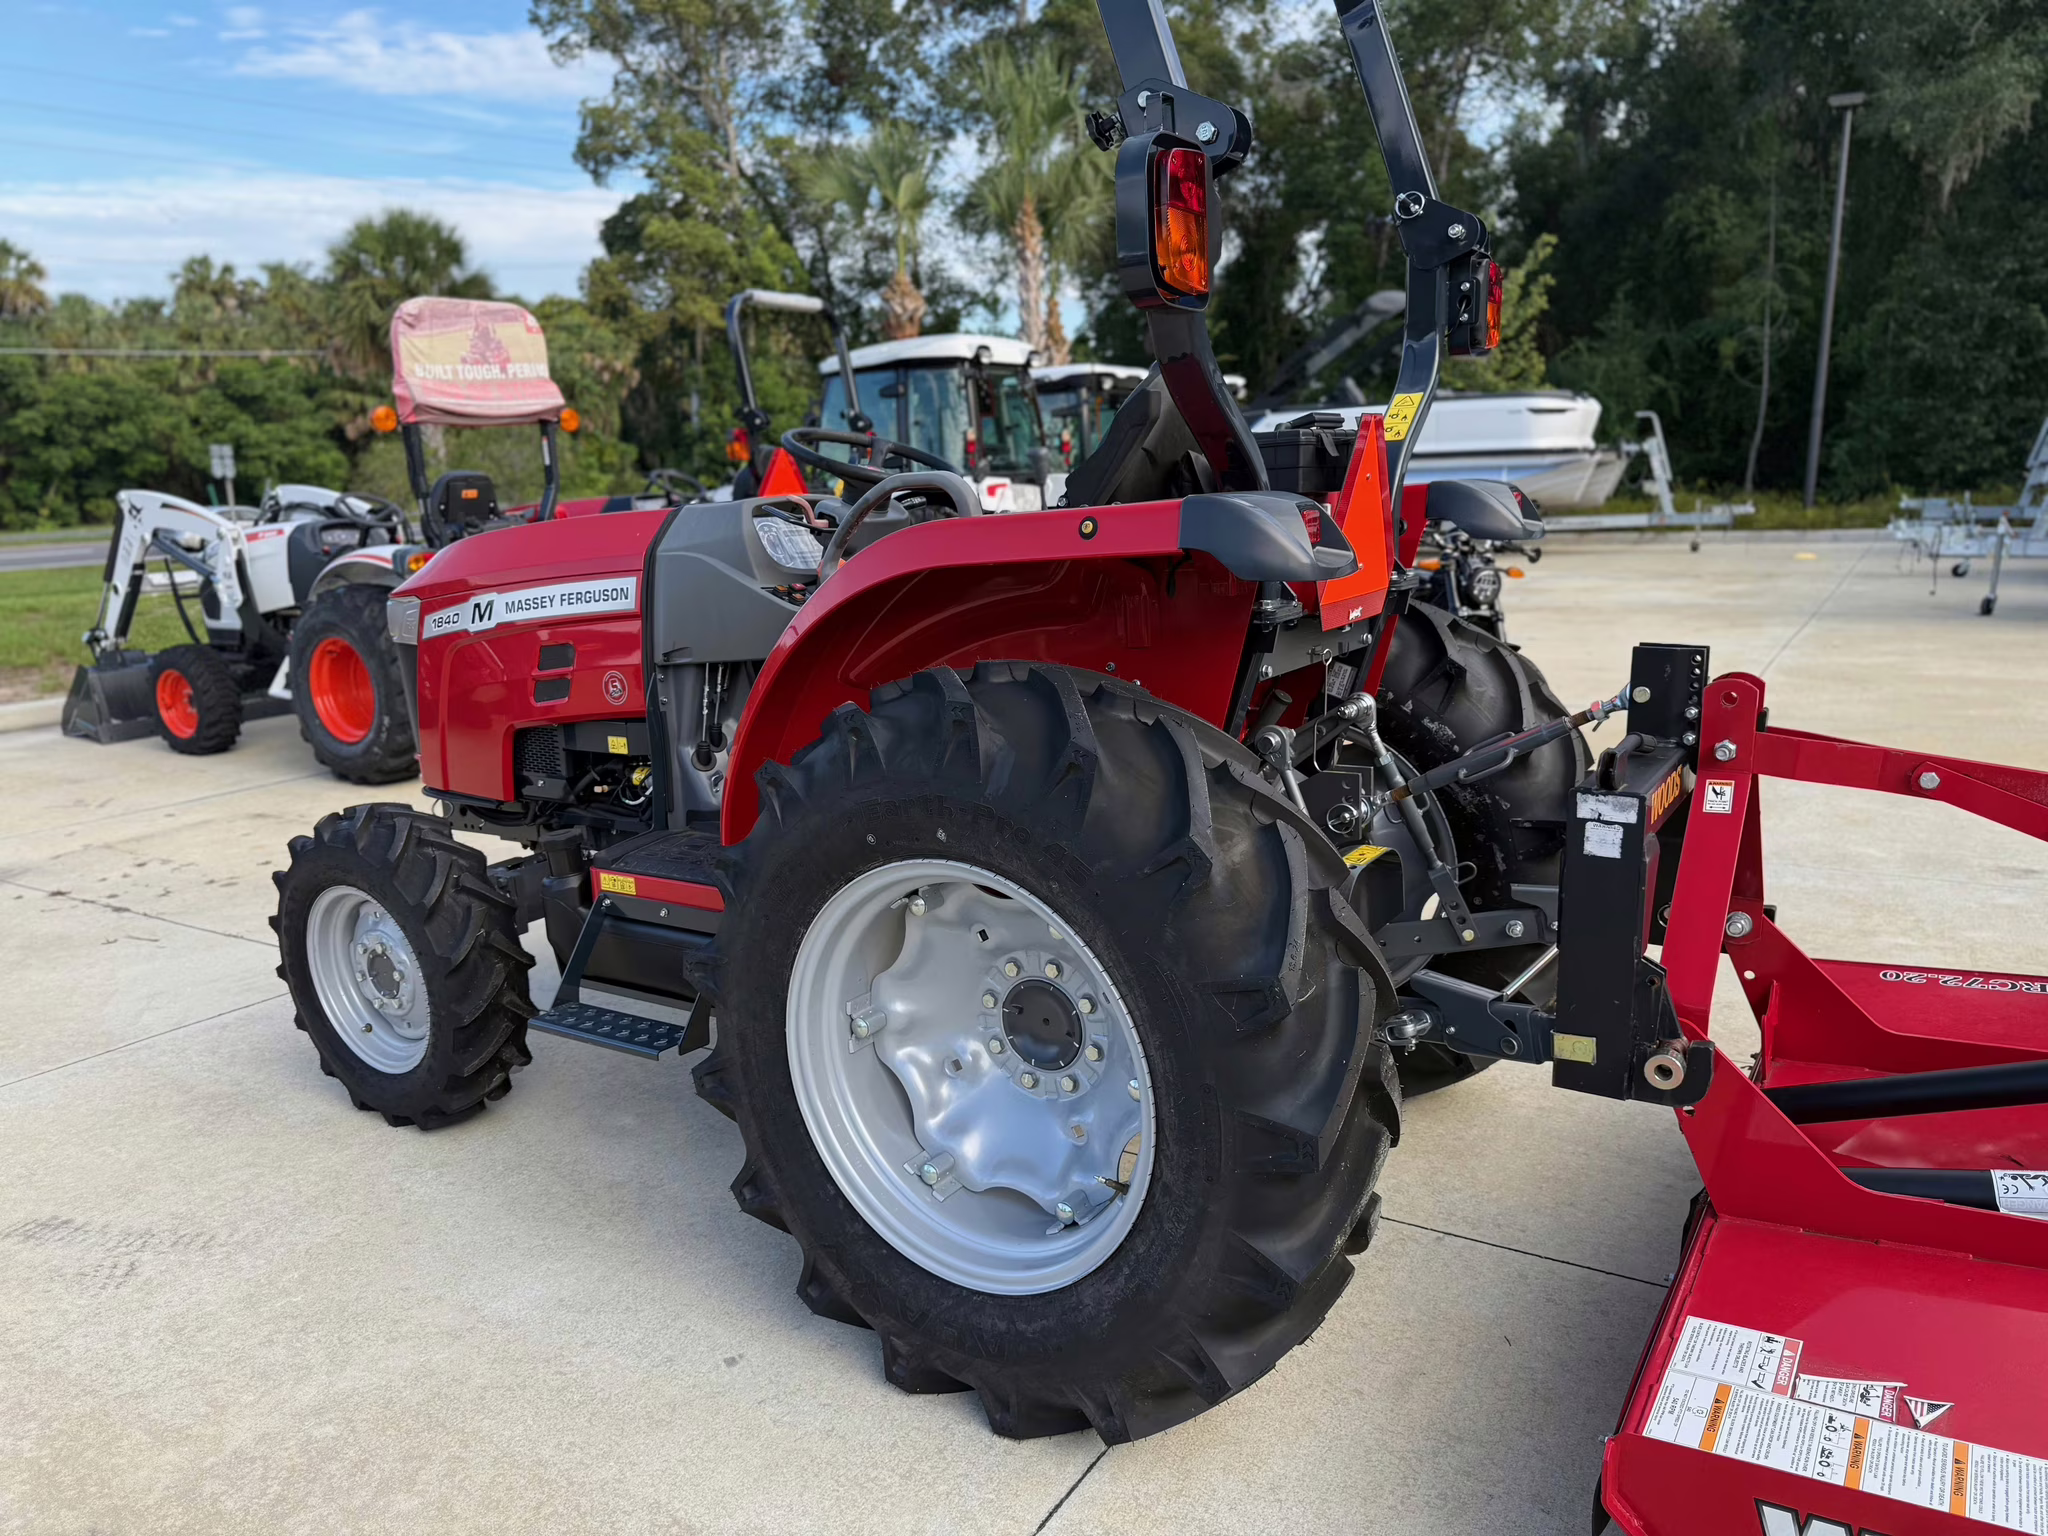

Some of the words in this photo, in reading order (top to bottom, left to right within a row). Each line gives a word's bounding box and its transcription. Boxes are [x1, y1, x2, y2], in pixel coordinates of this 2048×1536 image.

[431, 612, 460, 630] 1840
[470, 599, 495, 625] M
[505, 594, 556, 615] MASSEY
[560, 586, 629, 607] FERGUSON
[1651, 764, 1684, 824] WOODS
[1776, 1357, 1793, 1386] DANGER
[1706, 1405, 1723, 1433] WARNING
[1880, 1390, 1896, 1418] DANGER
[1849, 1440, 1863, 1470] WARNING
[1953, 1466, 1965, 1498] WARNING
